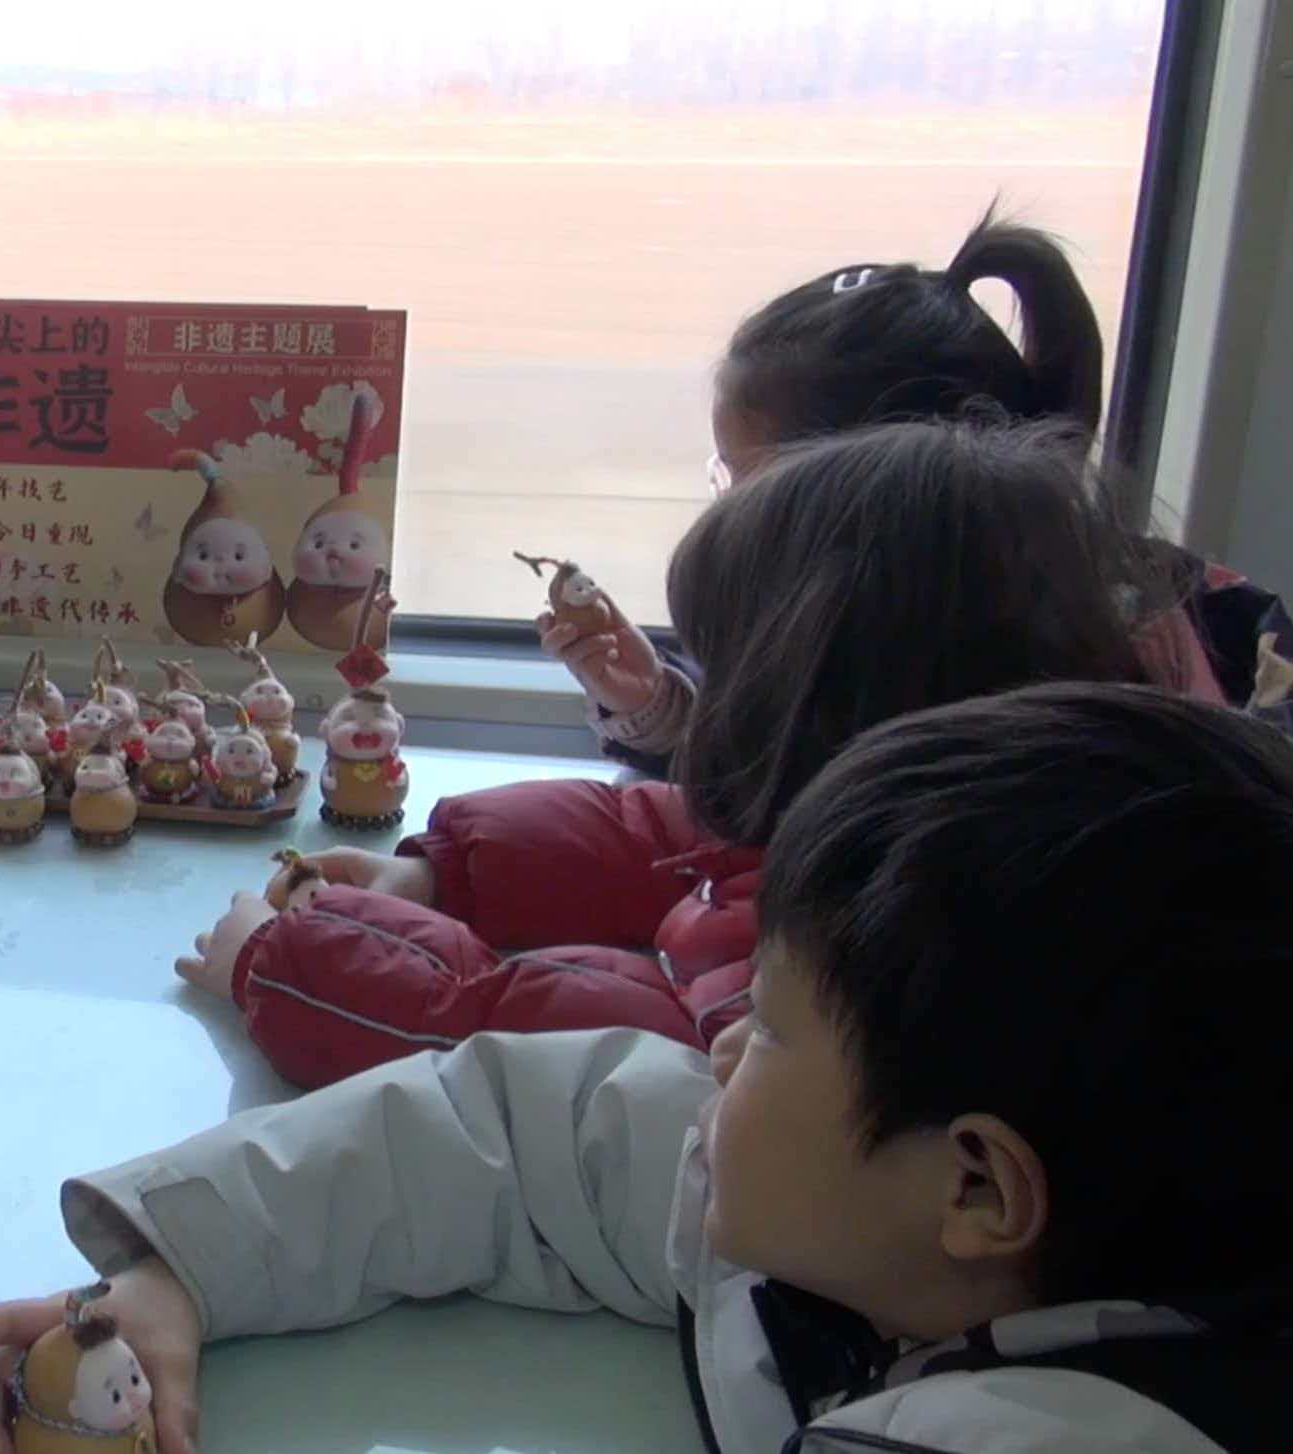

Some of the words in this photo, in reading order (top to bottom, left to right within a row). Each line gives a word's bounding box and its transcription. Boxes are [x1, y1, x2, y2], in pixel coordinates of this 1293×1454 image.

[173, 321, 336, 355] 非遗主题展
[183, 362, 229, 375] Cultural
[233, 363, 282, 378] Heritage
[287, 364, 328, 376] Theme
